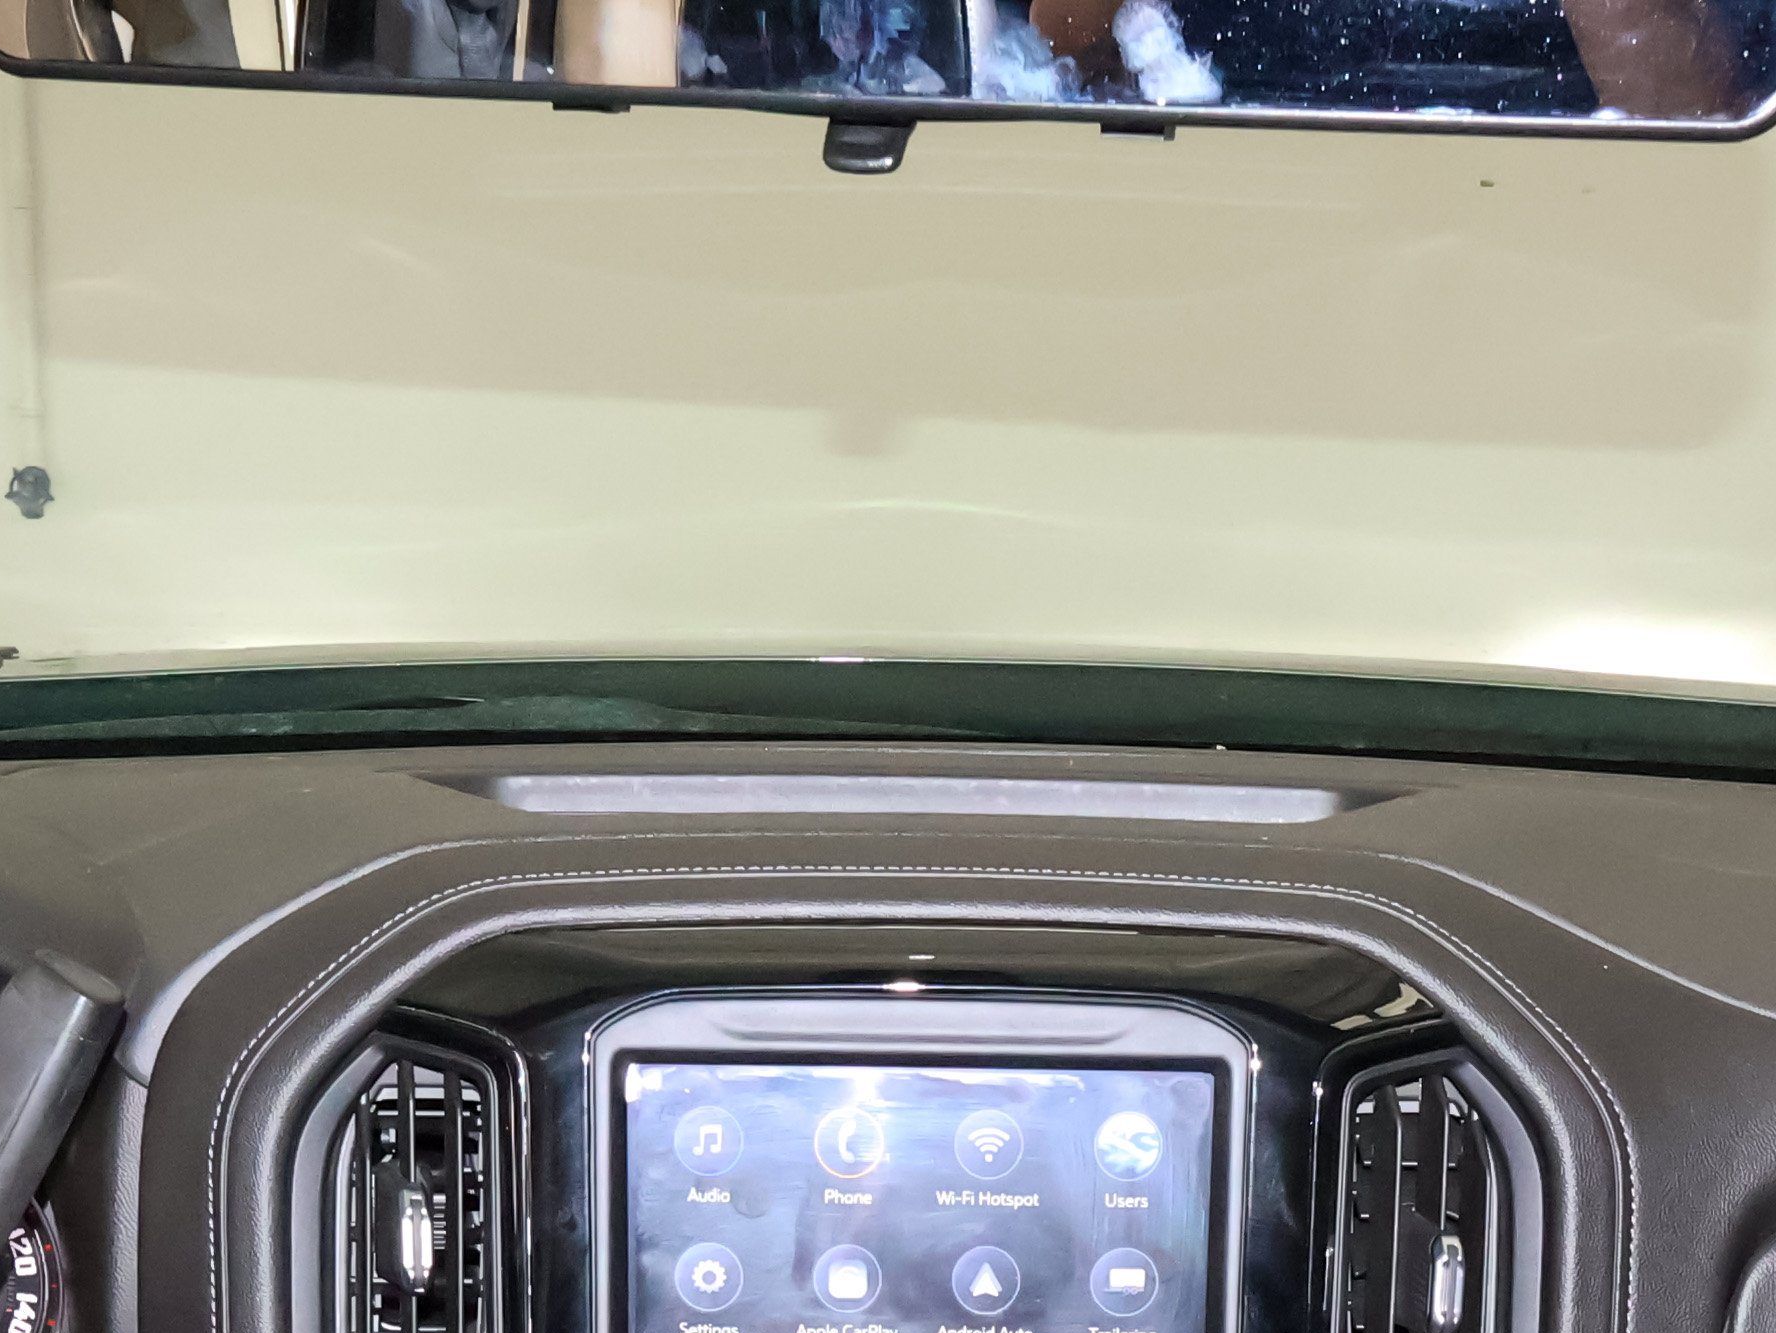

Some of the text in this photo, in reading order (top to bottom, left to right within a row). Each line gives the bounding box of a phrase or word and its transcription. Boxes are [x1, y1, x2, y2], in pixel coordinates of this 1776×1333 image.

[687, 1187, 731, 1203] Audio
[824, 1189, 873, 1205] Phone
[936, 1190, 1040, 1210] Wi-Fi Hotspot
[1105, 1193, 1149, 1208] Users
[8, 1227, 38, 1276] 120
